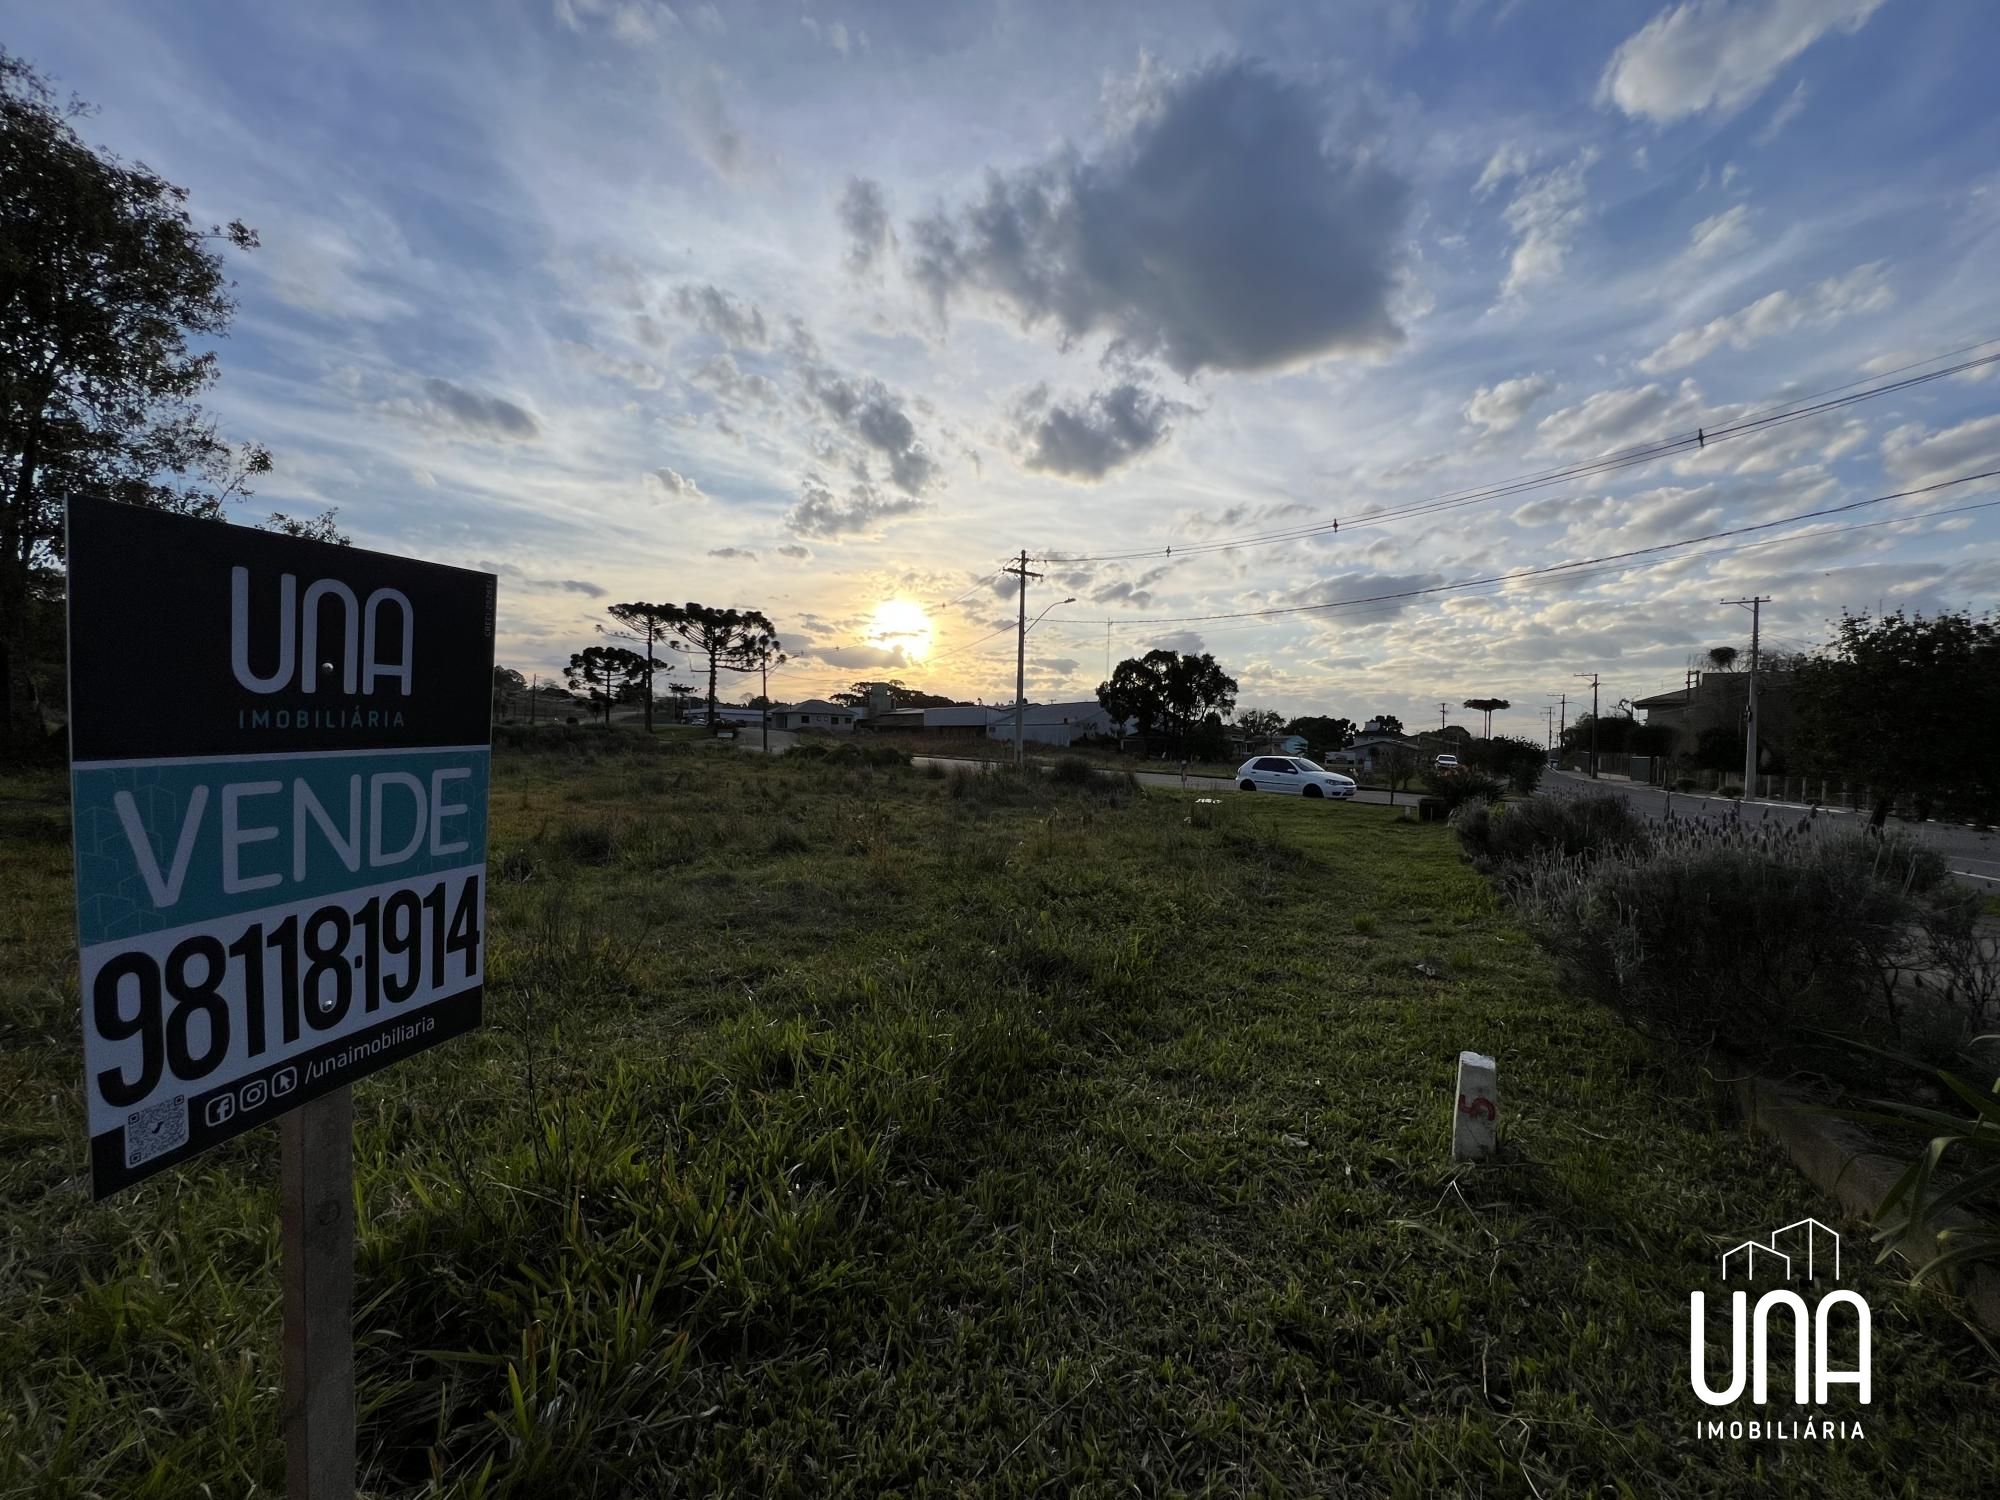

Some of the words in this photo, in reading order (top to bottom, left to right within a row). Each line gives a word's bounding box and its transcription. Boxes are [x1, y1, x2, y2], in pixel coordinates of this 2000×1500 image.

[231, 565, 414, 696] UNA
[238, 705, 405, 729] IMOBILIÁRIA
[113, 767, 472, 908] VENDE
[305, 1016, 435, 1085] /unaimobiliaria
